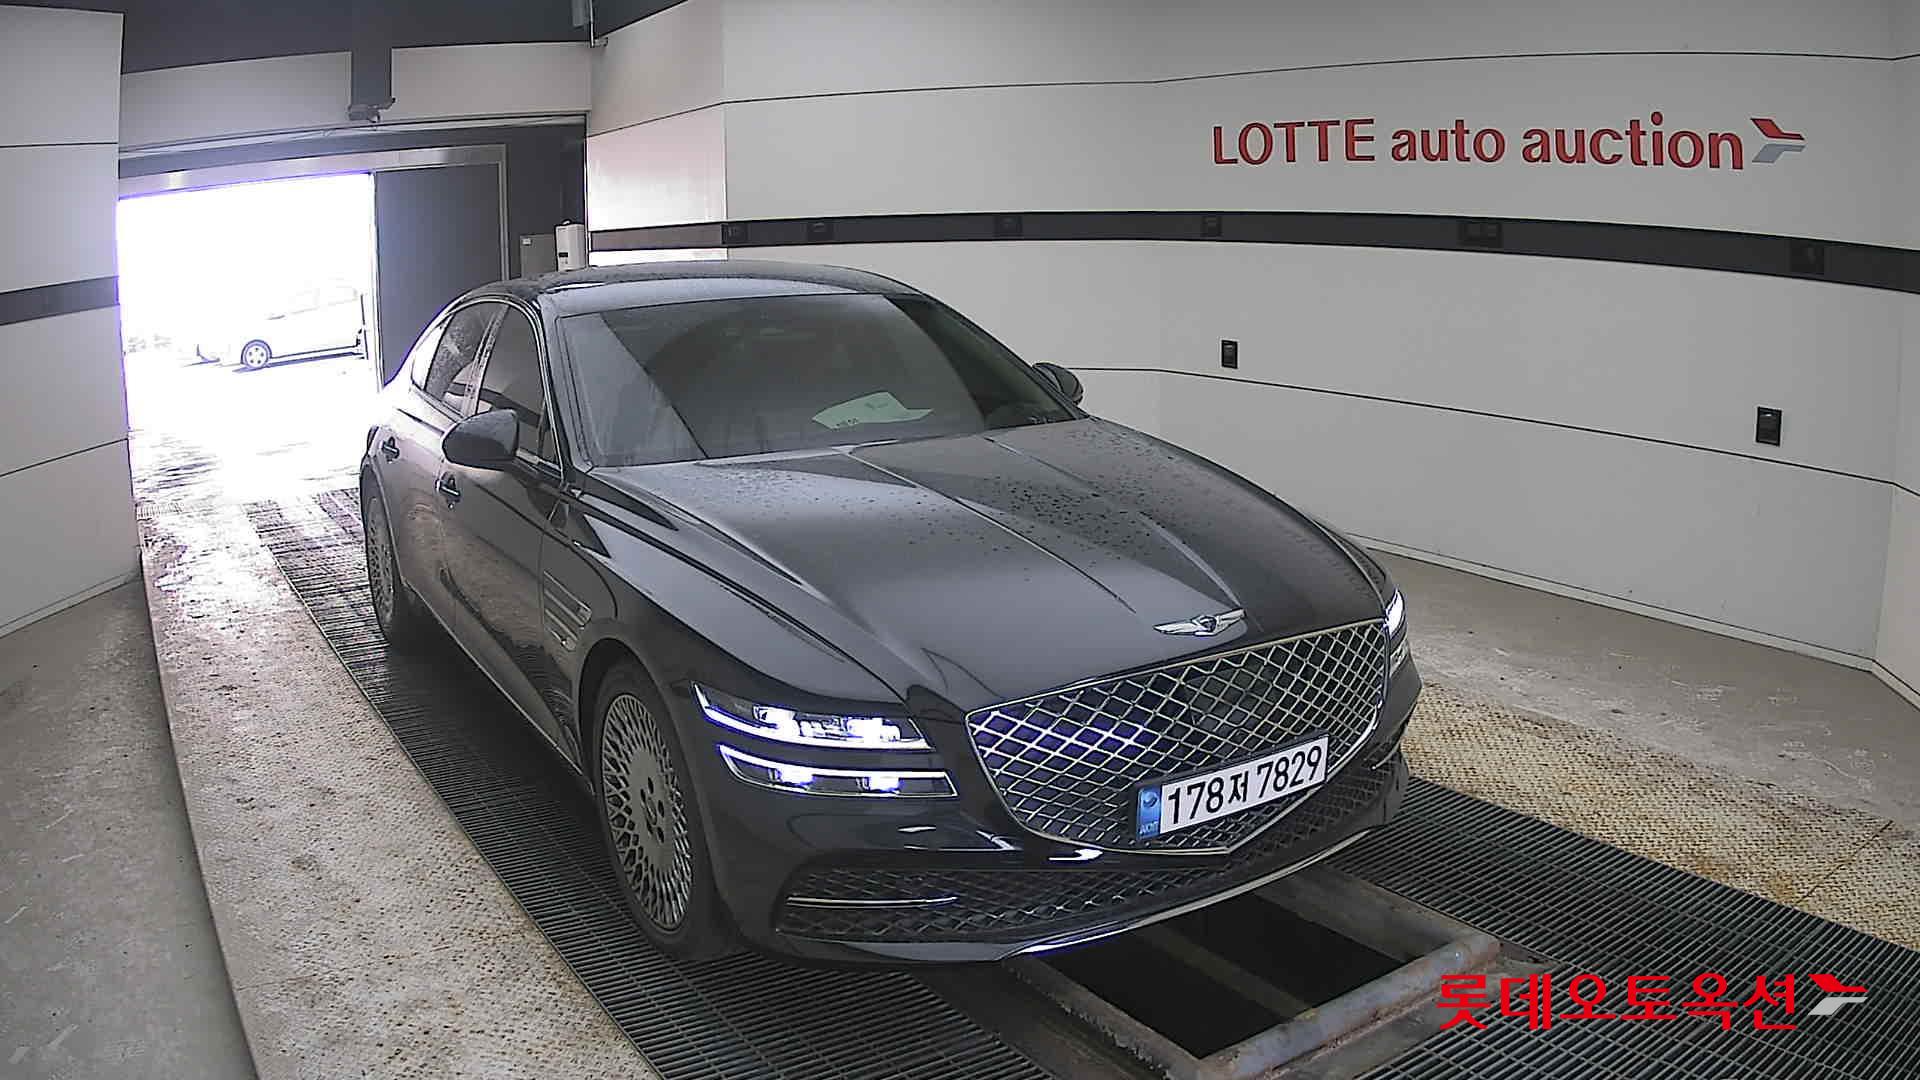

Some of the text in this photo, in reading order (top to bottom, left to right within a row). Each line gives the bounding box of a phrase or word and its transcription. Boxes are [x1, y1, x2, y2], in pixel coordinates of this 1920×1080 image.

[1213, 111, 1744, 170] LOTTE auto auction
[1167, 745, 1322, 825] 178저 7829
